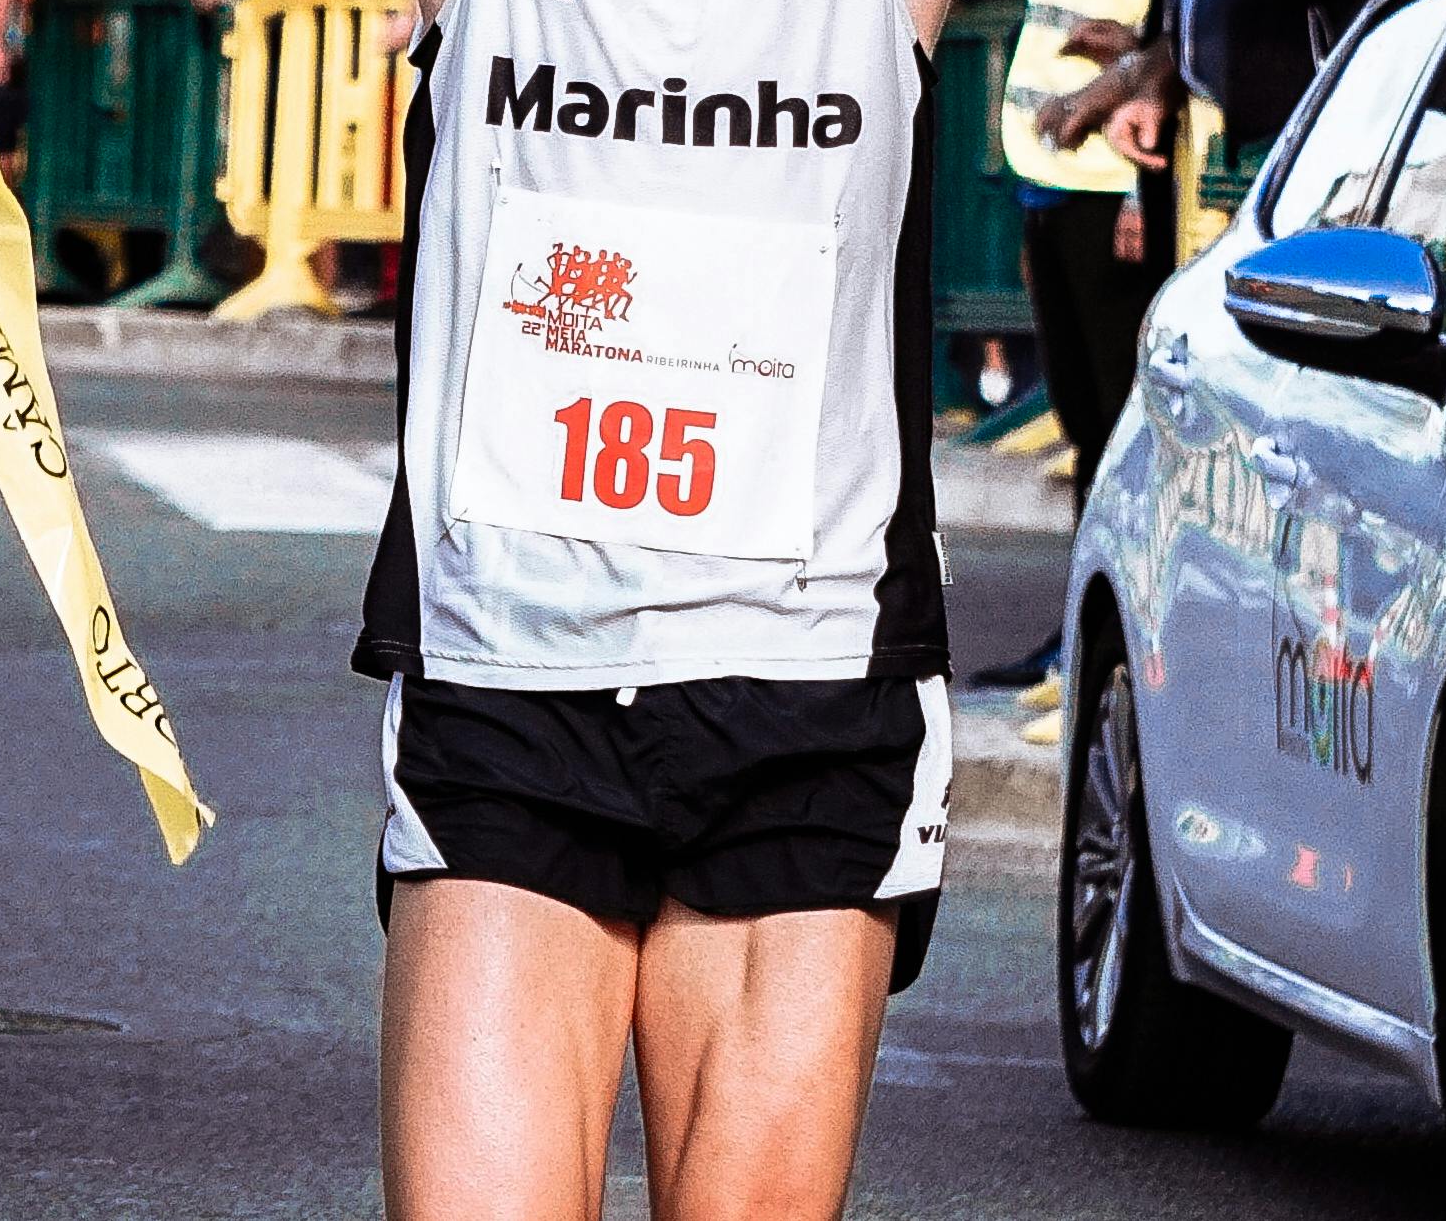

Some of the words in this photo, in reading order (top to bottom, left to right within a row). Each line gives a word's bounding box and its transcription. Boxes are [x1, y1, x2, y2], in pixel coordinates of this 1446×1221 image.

[484, 55, 863, 150] Marinha
[546, 324, 587, 344] MEIA
[547, 310, 604, 333] MOITA
[545, 337, 644, 364] MARATONA
[646, 354, 721, 373] RIBEIRINHA
[731, 357, 796, 379] moita
[552, 396, 719, 518] 185
